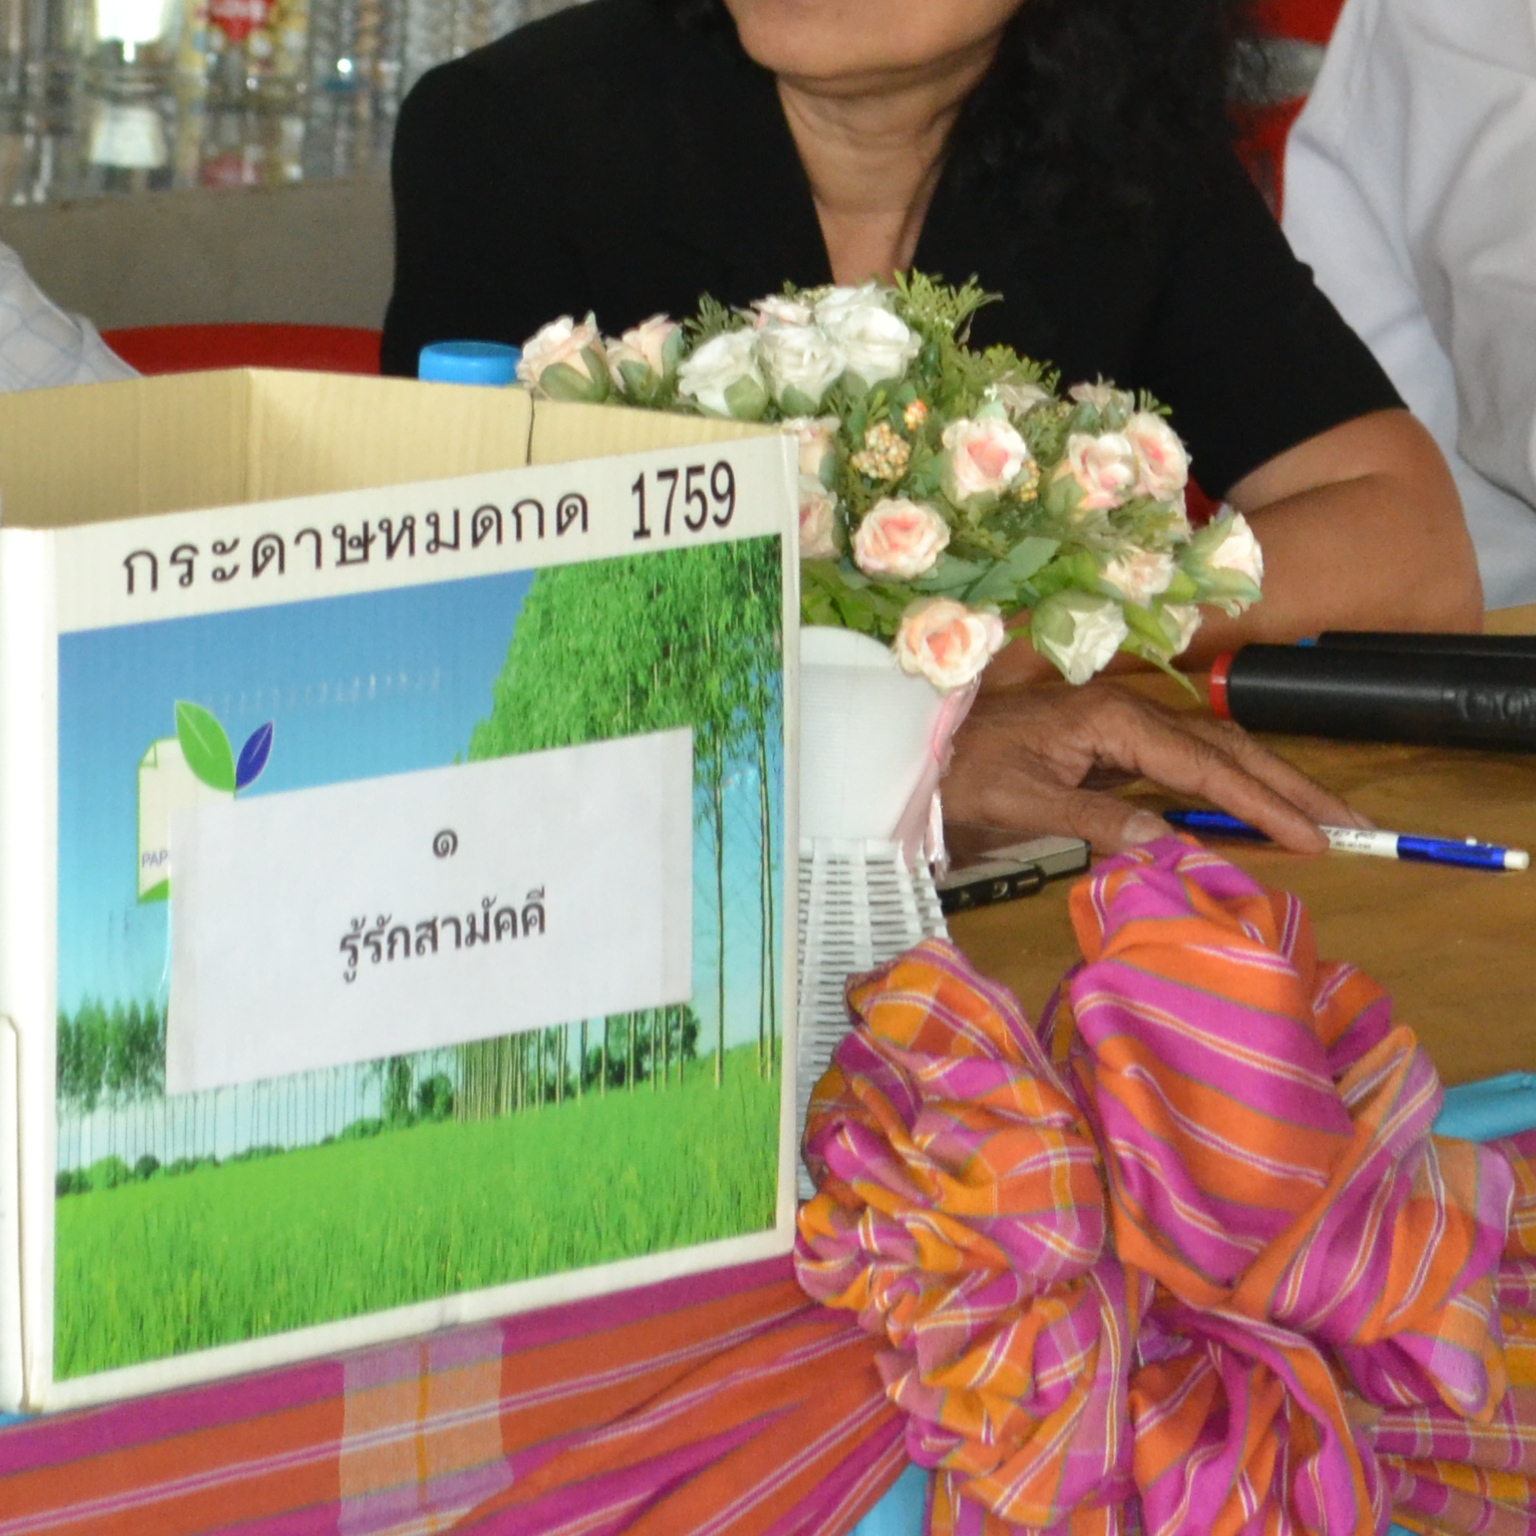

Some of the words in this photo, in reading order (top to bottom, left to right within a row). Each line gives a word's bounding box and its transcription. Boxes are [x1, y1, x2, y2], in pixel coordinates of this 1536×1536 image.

[122, 484, 590, 595] กระดาษหมดกด
[631, 460, 737, 541] 1759
[339, 885, 546, 982] รู้รักสามัคคี
